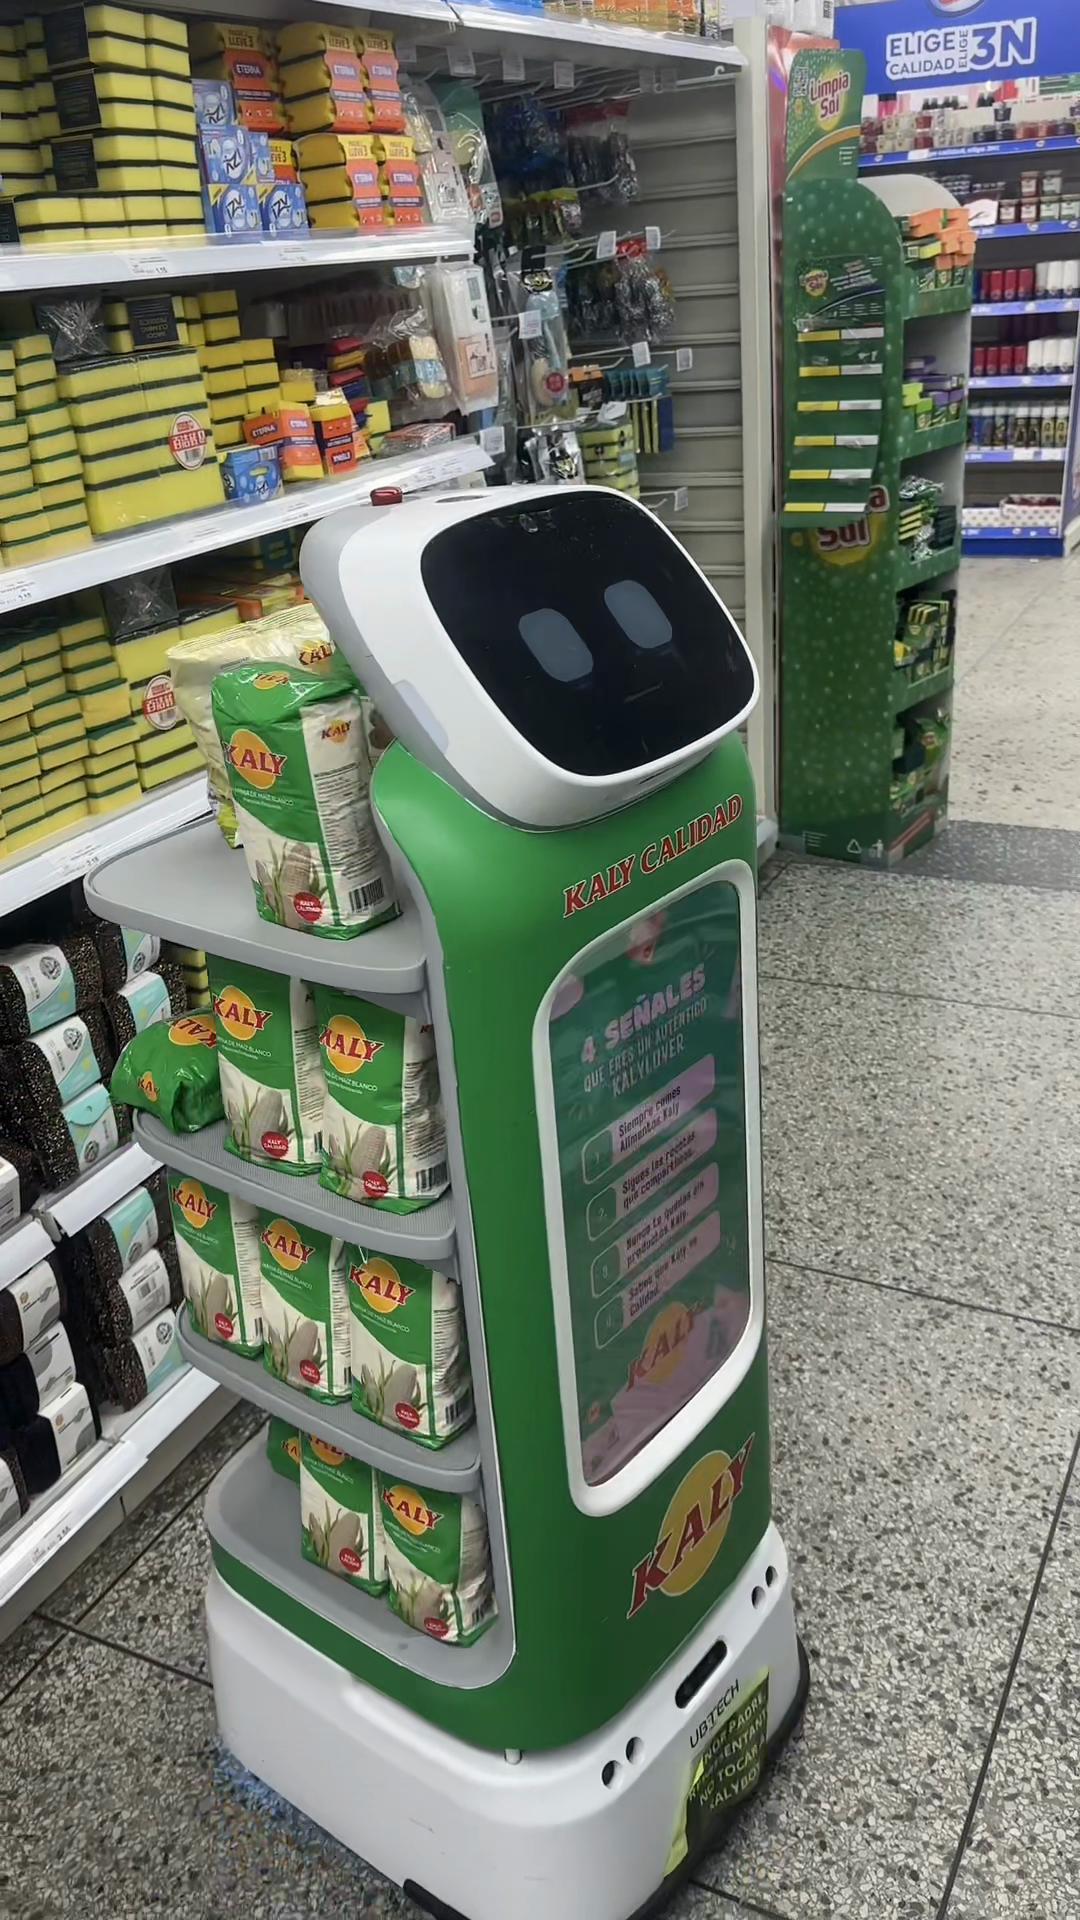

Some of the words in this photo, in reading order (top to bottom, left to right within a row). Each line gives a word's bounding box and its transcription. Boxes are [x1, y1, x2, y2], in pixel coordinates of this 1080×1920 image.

[890, 31, 955, 57] ELIGE
[958, 29, 968, 69] ELIGE
[970, 21, 1031, 66] 3N
[810, 71, 849, 101] Limpia
[890, 57, 954, 76] CALIDAD
[820, 95, 839, 118] Sol
[252, 424, 276, 437] ETERNA
[321, 720, 352, 740] KALY
[222, 737, 288, 778] KALY
[562, 854, 636, 919] KALY
[640, 793, 744, 874] CALIDAD
[212, 994, 272, 1031] KALY
[582, 1035, 596, 1064] 4
[604, 963, 706, 1050] SEÑALES
[319, 1026, 384, 1062] KALY
[584, 1064, 604, 1093] QUE
[608, 1046, 634, 1074] ERES
[612, 1033, 685, 1098] KALYLOVER
[618, 1106, 654, 1137] Siempre
[655, 1086, 681, 1111] comes
[620, 1118, 663, 1152] Alimentos
[663, 1101, 680, 1123] Kaly
[622, 1164, 650, 1194] Sigues
[651, 1156, 664, 1171] las
[172, 1188, 218, 1220] KALY
[260, 1230, 316, 1264] KALY
[349, 1264, 416, 1306] KALY
[383, 1487, 444, 1530] KALY
[626, 1431, 756, 1620] KALY
[690, 1678, 740, 1749] UBTECH
